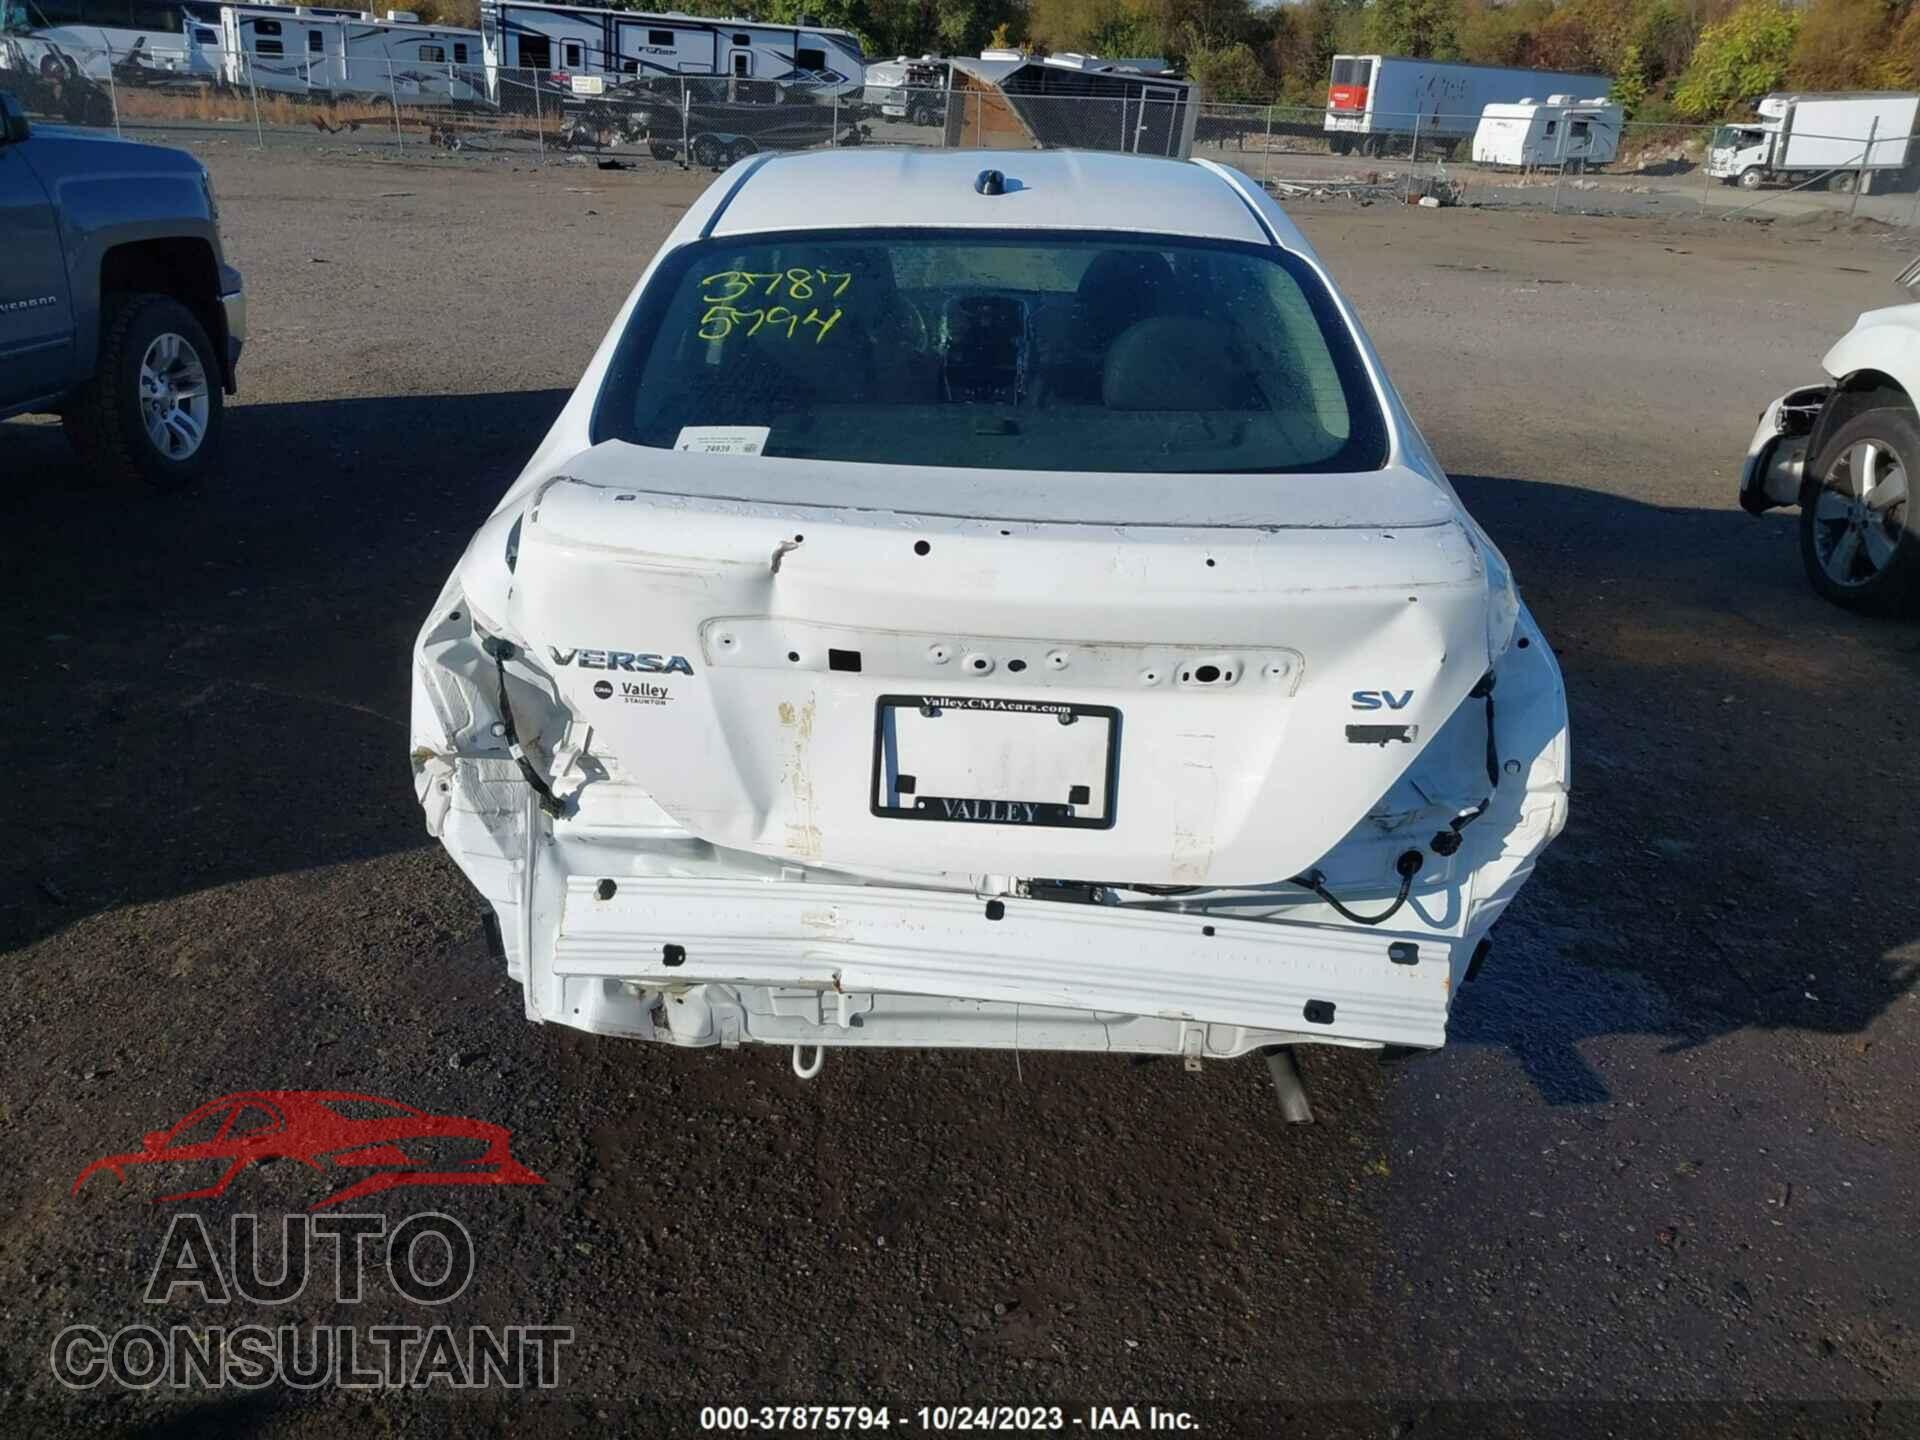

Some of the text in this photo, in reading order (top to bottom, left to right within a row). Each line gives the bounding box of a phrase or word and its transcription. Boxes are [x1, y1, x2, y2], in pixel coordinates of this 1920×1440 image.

[701, 268, 851, 302] 3787
[698, 306, 842, 344] 5794
[549, 646, 695, 676] VERSA
[622, 682, 668, 699] Valley
[624, 697, 666, 706] STAUNTON
[1351, 689, 1415, 711] SV
[921, 697, 1072, 714] Valley.CMAcars.com
[943, 799, 1039, 823] VALLEY
